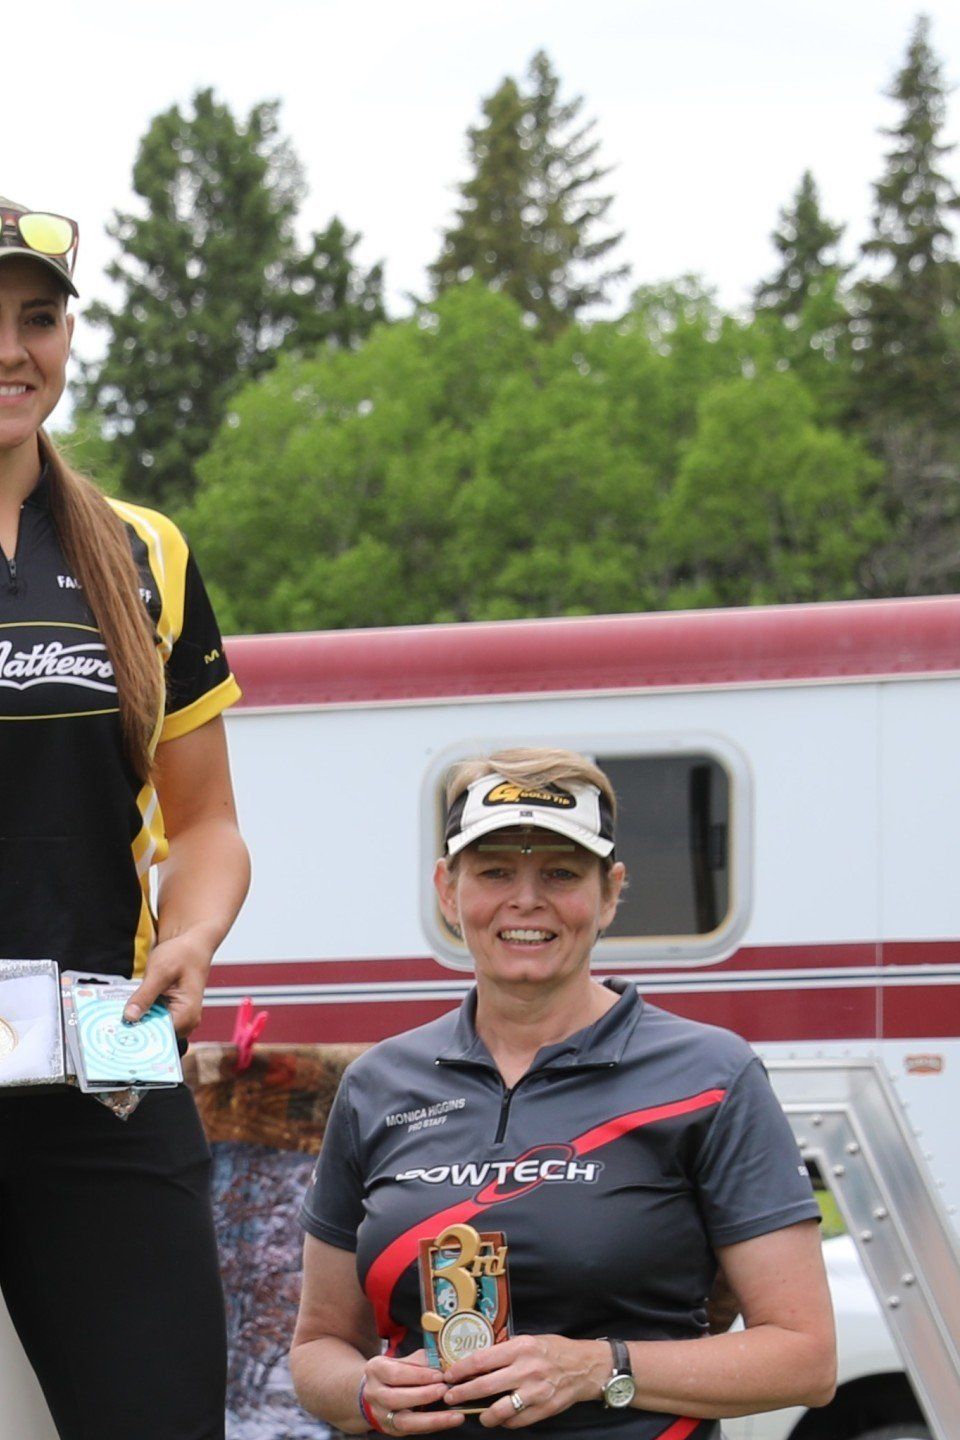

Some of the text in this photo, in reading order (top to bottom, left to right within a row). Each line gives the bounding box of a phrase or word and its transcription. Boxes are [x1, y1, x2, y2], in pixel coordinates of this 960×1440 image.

[386, 1098, 466, 1127] MONICA HIGGINS
[422, 1115, 448, 1128] STAFF
[421, 1223, 508, 1332] 3rd
[454, 1333, 488, 1352] 2019
